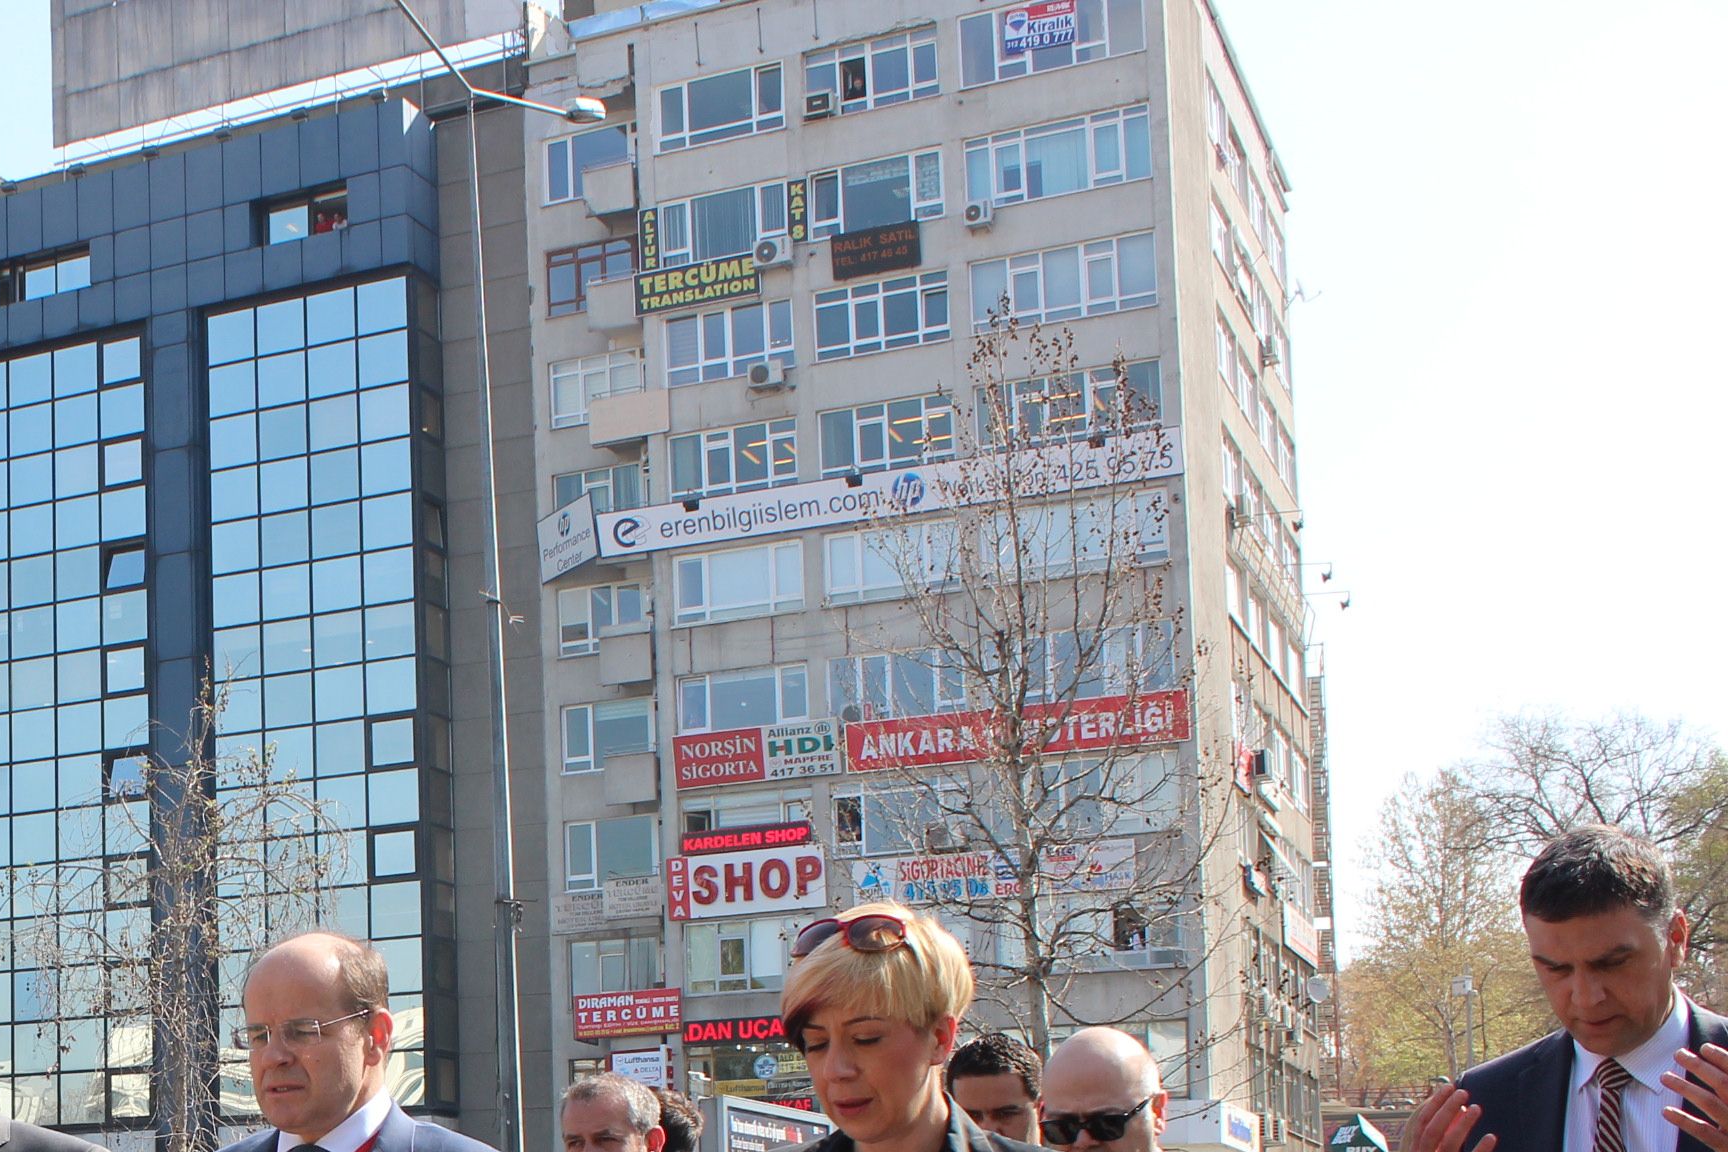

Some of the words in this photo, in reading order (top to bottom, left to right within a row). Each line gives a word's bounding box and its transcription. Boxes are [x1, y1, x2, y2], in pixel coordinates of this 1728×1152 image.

[1027, 16, 1072, 34] Kiralık
[1020, 36, 1040, 48] 419
[1043, 34, 1050, 43] 0
[1053, 30, 1073, 42] 777
[790, 183, 805, 220] KAT
[643, 210, 657, 270] ALTUR
[791, 225, 805, 240] 8
[640, 253, 755, 295] TERCÜME
[641, 281, 756, 310] TRANSLATION
[660, 490, 879, 539] erenbilgiislem.com
[543, 526, 592, 562] Performance
[556, 549, 584, 573] Center
[768, 726, 811, 739] Allianz
[860, 725, 974, 762] ANKARA
[681, 735, 756, 760] NORŞİN
[767, 735, 834, 758] HDI
[681, 760, 758, 781] SİGORTA
[770, 765, 794, 778] 417
[799, 764, 816, 775] 36
[819, 763, 835, 774] 51
[784, 753, 833, 766] MAPFRE
[683, 829, 762, 851] KARDELEN
[765, 826, 809, 844] SHOP
[616, 878, 649, 888] ENDER
[671, 860, 686, 918] DEVA
[692, 855, 821, 906] SHOP
[578, 995, 634, 1009] DIRAMAN
[578, 1005, 680, 1025] TERCÜME
[684, 1020, 732, 1043] DAN
[738, 1017, 786, 1041] UÇA
[624, 1056, 660, 1065] Lufthansa
[639, 1066, 660, 1074] DELTA
[1338, 1125, 1360, 1135] BUY
